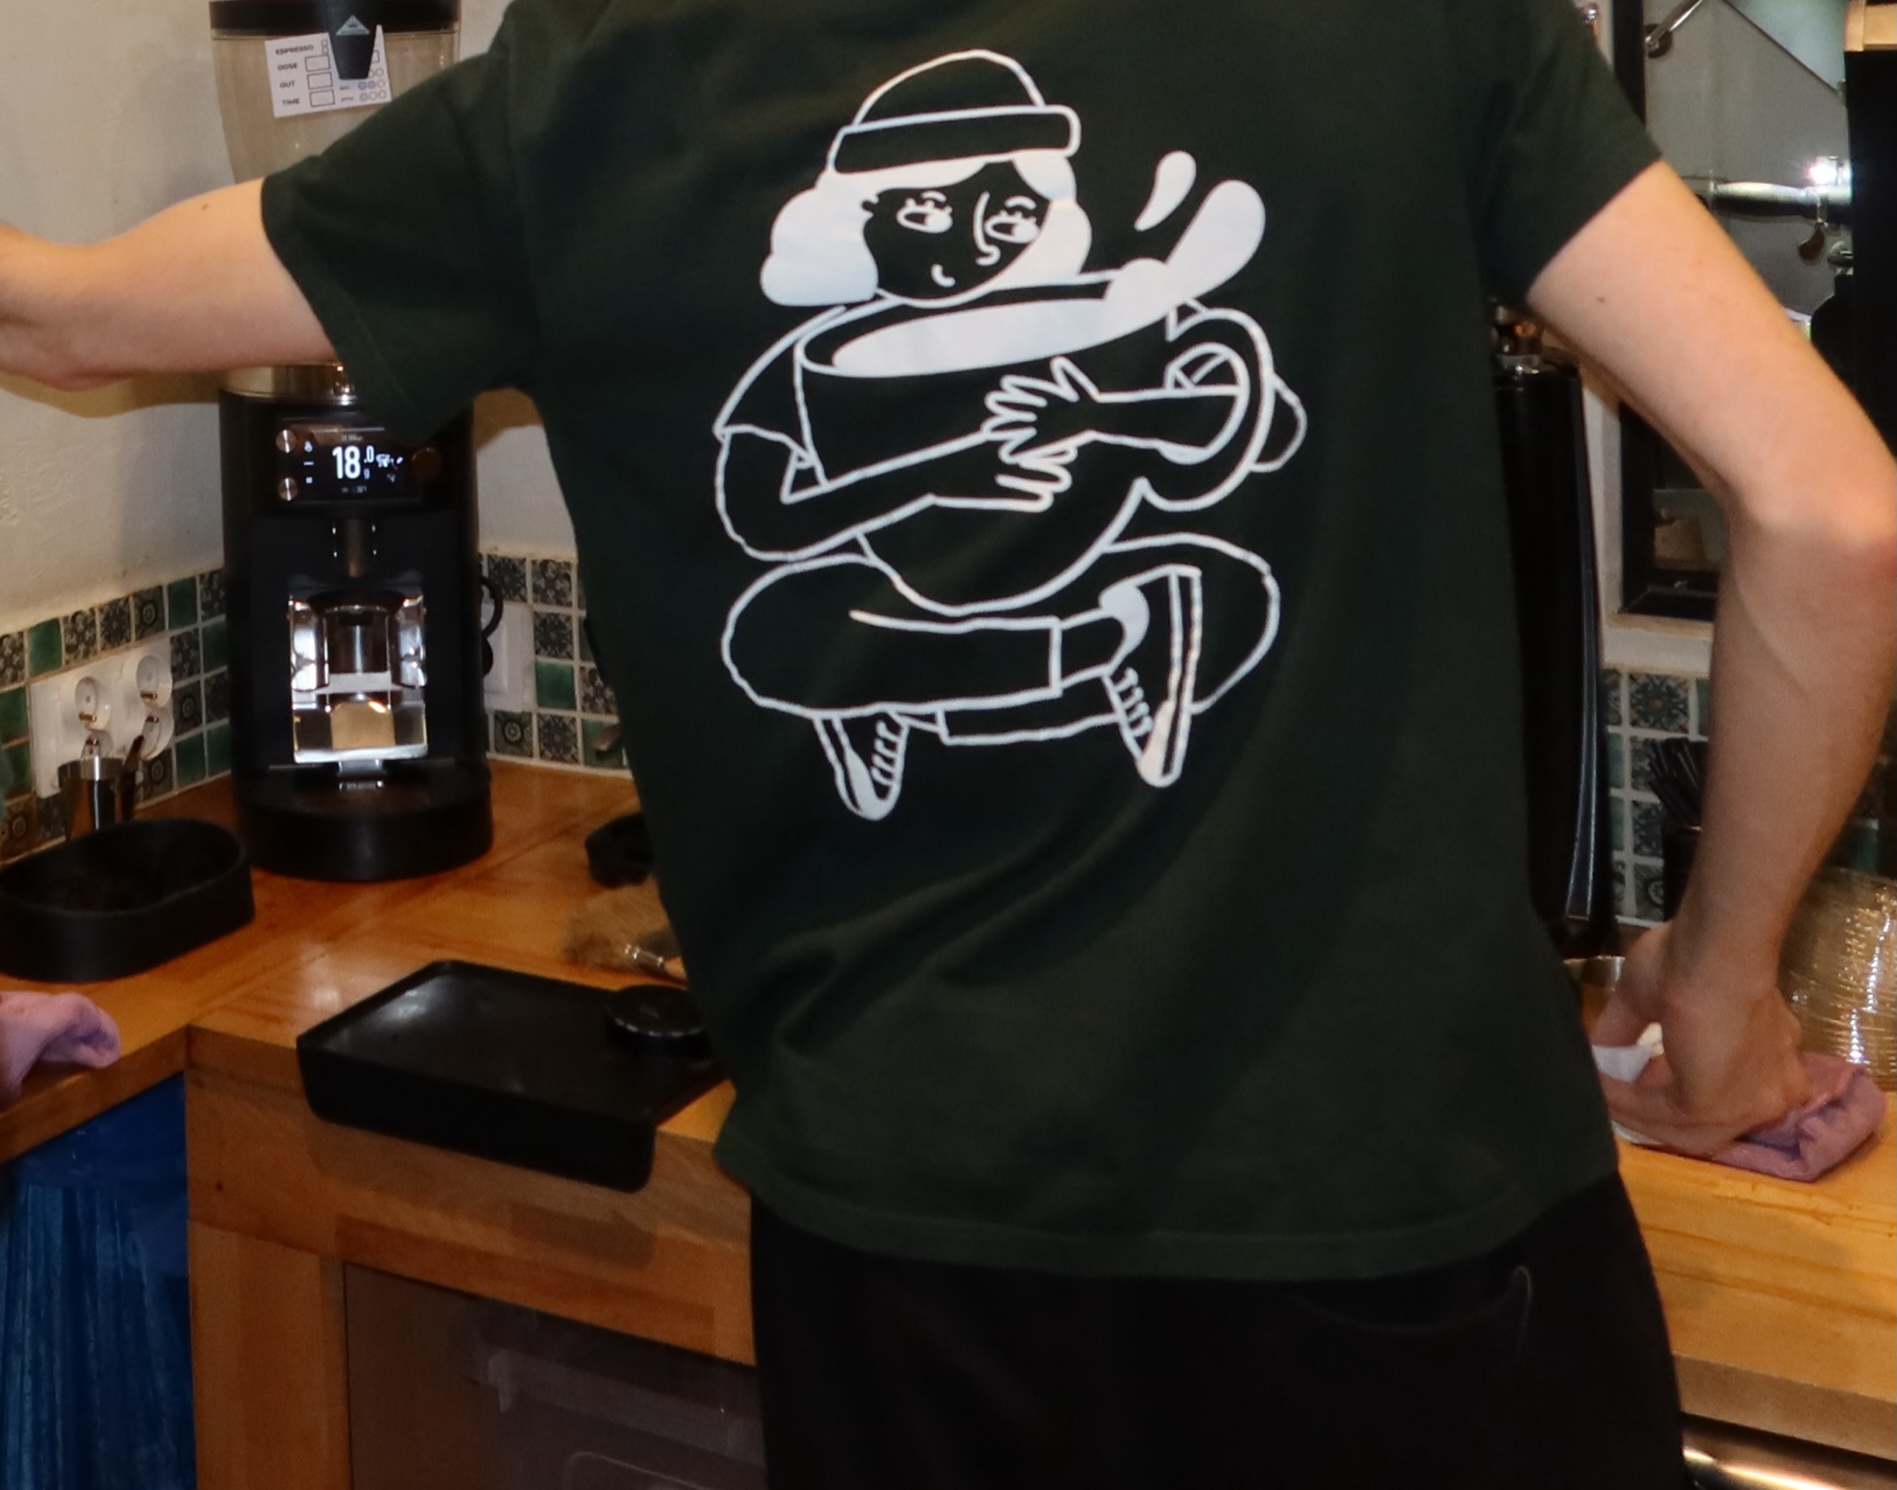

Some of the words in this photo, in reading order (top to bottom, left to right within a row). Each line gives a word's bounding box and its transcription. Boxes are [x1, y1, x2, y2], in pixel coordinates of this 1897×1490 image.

[275, 44, 313, 55] ESPRESSO
[277, 62, 299, 71] DOSE
[279, 80, 296, 89] OUT
